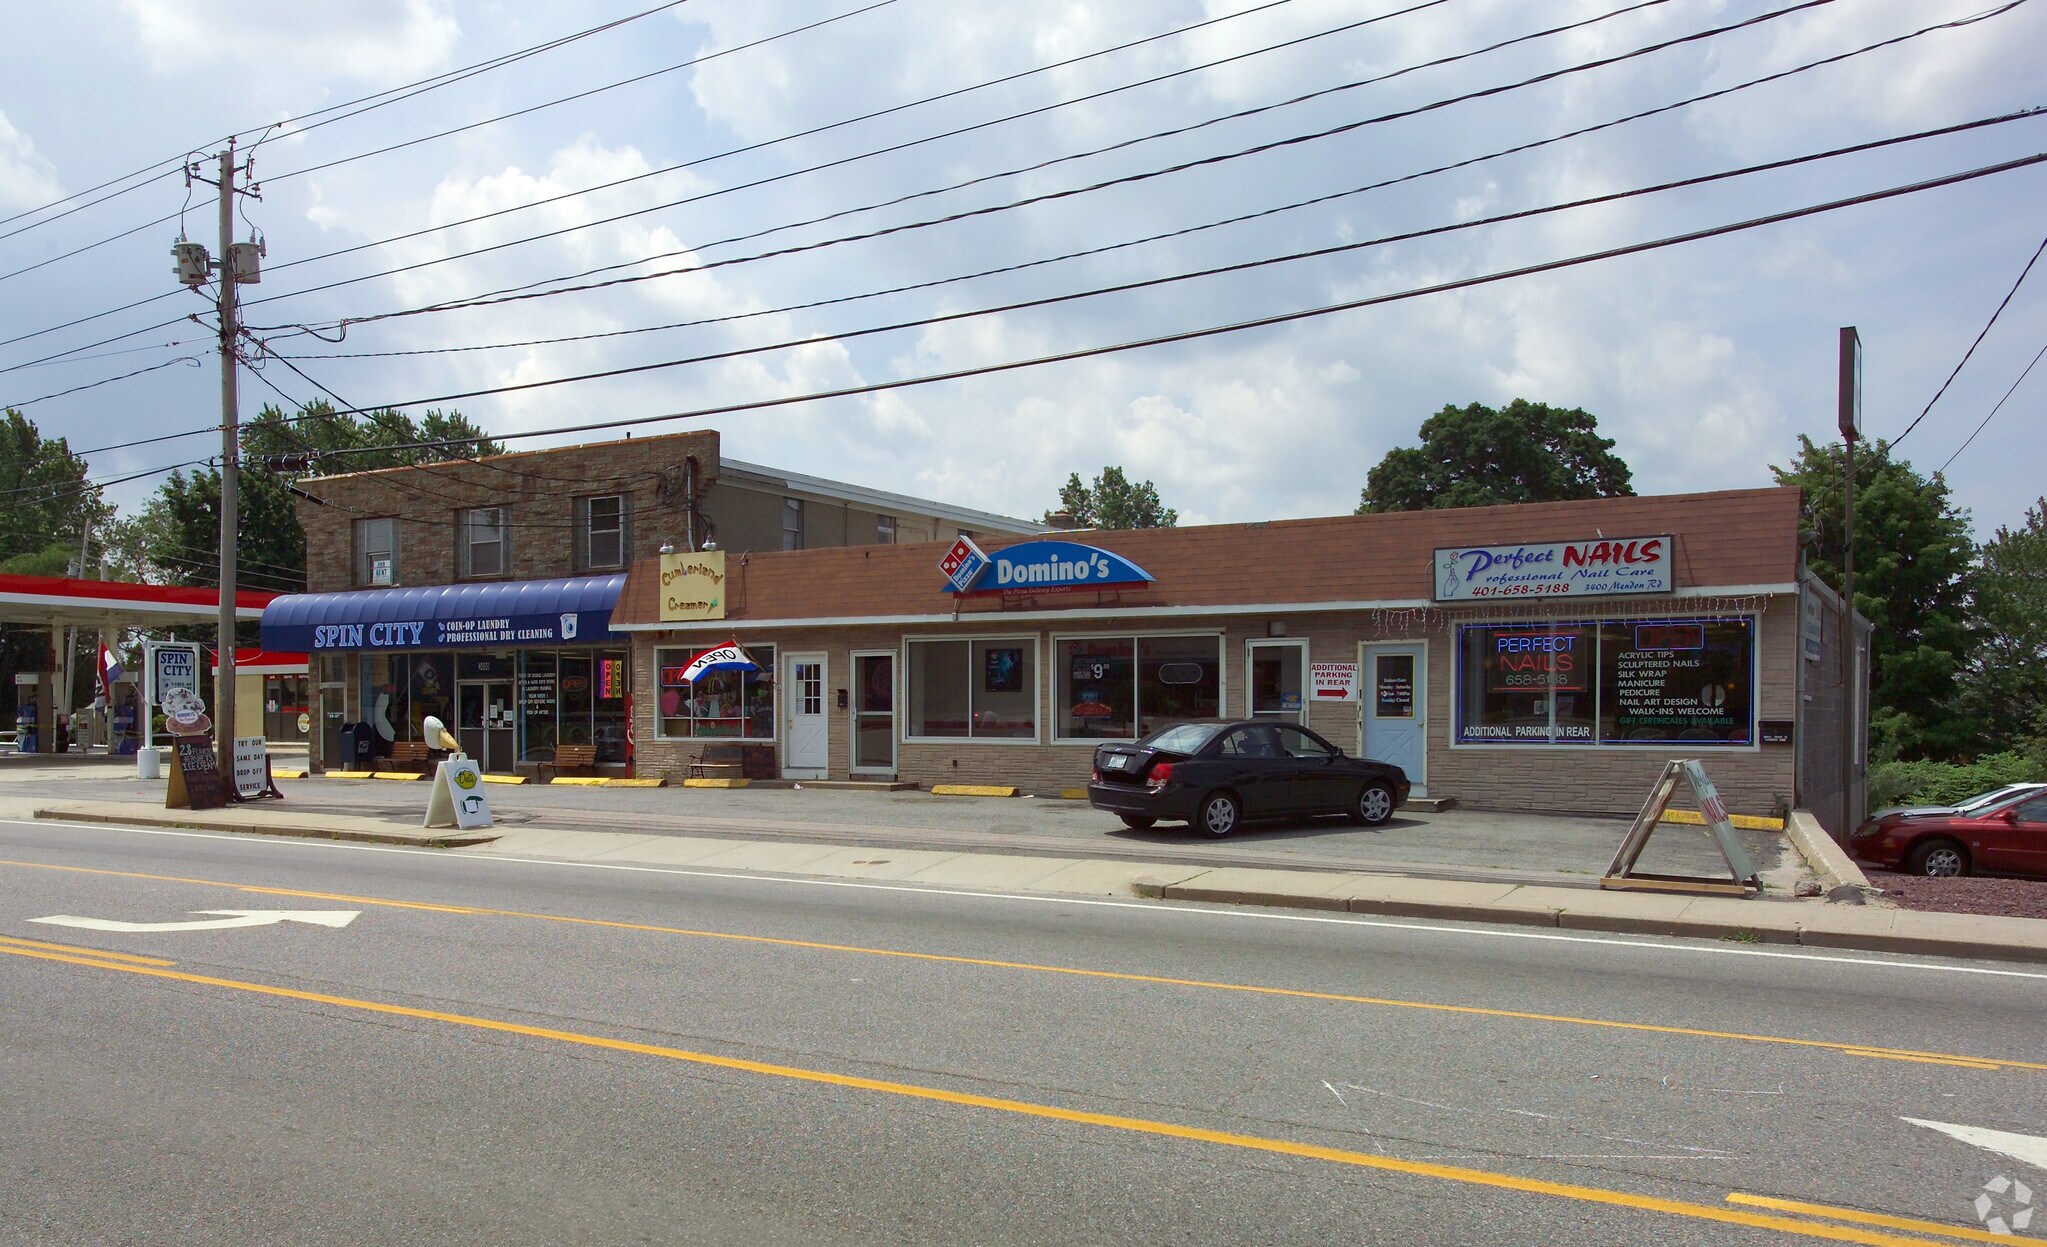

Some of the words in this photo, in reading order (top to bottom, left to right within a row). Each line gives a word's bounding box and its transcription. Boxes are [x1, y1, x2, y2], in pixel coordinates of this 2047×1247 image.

[1460, 548, 1554, 582] Perfect
[1562, 539, 1663, 568] NAILS
[375, 568, 388, 576] RENT
[661, 560, 724, 587] Cumberland
[953, 554, 976, 582] Domino's
[997, 553, 1110, 584] Domino's
[1571, 568, 1610, 581] Nail
[1615, 566, 1655, 577] Care
[1471, 583, 1570, 597] 401-658-5188
[1584, 582, 1608, 592] 3400
[1608, 580, 1645, 592] Mendon
[1647, 579, 1663, 589] Rd
[446, 620, 476, 631] COIN-OP
[477, 619, 510, 630] LAUNDRY
[314, 624, 364, 648] SPIN
[369, 621, 425, 646] CITY
[446, 631, 498, 643] PROFESSIONAL
[500, 630, 516, 641] DRY
[517, 628, 553, 640] CLEANING
[1498, 636, 1576, 653] PERFECT
[160, 653, 188, 664] SPIN
[1618, 651, 1654, 660] ACRYLIC
[1656, 650, 1675, 659] TIPS
[1500, 654, 1573, 672] NAILS
[1618, 660, 1670, 669] SCULPTERED
[1673, 659, 1700, 668] NAILS
[163, 665, 192, 676] CITY
[1618, 670, 1636, 678] SILK
[1639, 670, 1668, 678] WRAP
[1618, 680, 1666, 688] MANICURE
[1619, 688, 1661, 697] PEDICURE
[1619, 698, 1640, 706] NAIL
[1643, 698, 1661, 706] ART
[1663, 698, 1698, 706] DESIGN
[1629, 707, 1674, 716] WALK-INS
[1677, 707, 1725, 715] WELCOME
[1619, 717, 1637, 725] GIFT
[1639, 717, 1688, 725] CERTIFICATES
[1690, 716, 1735, 725] AVAILABLE
[1464, 726, 1512, 737] ADDITIONAL
[1515, 726, 1552, 737] PARKING
[1556, 727, 1565, 737] IN
[1566, 727, 1590, 737] REAR
[179, 744, 192, 756] 28
[182, 762, 196, 772] ICE
[252, 767, 262, 775] OFF
[239, 782, 261, 791] SERVICE
